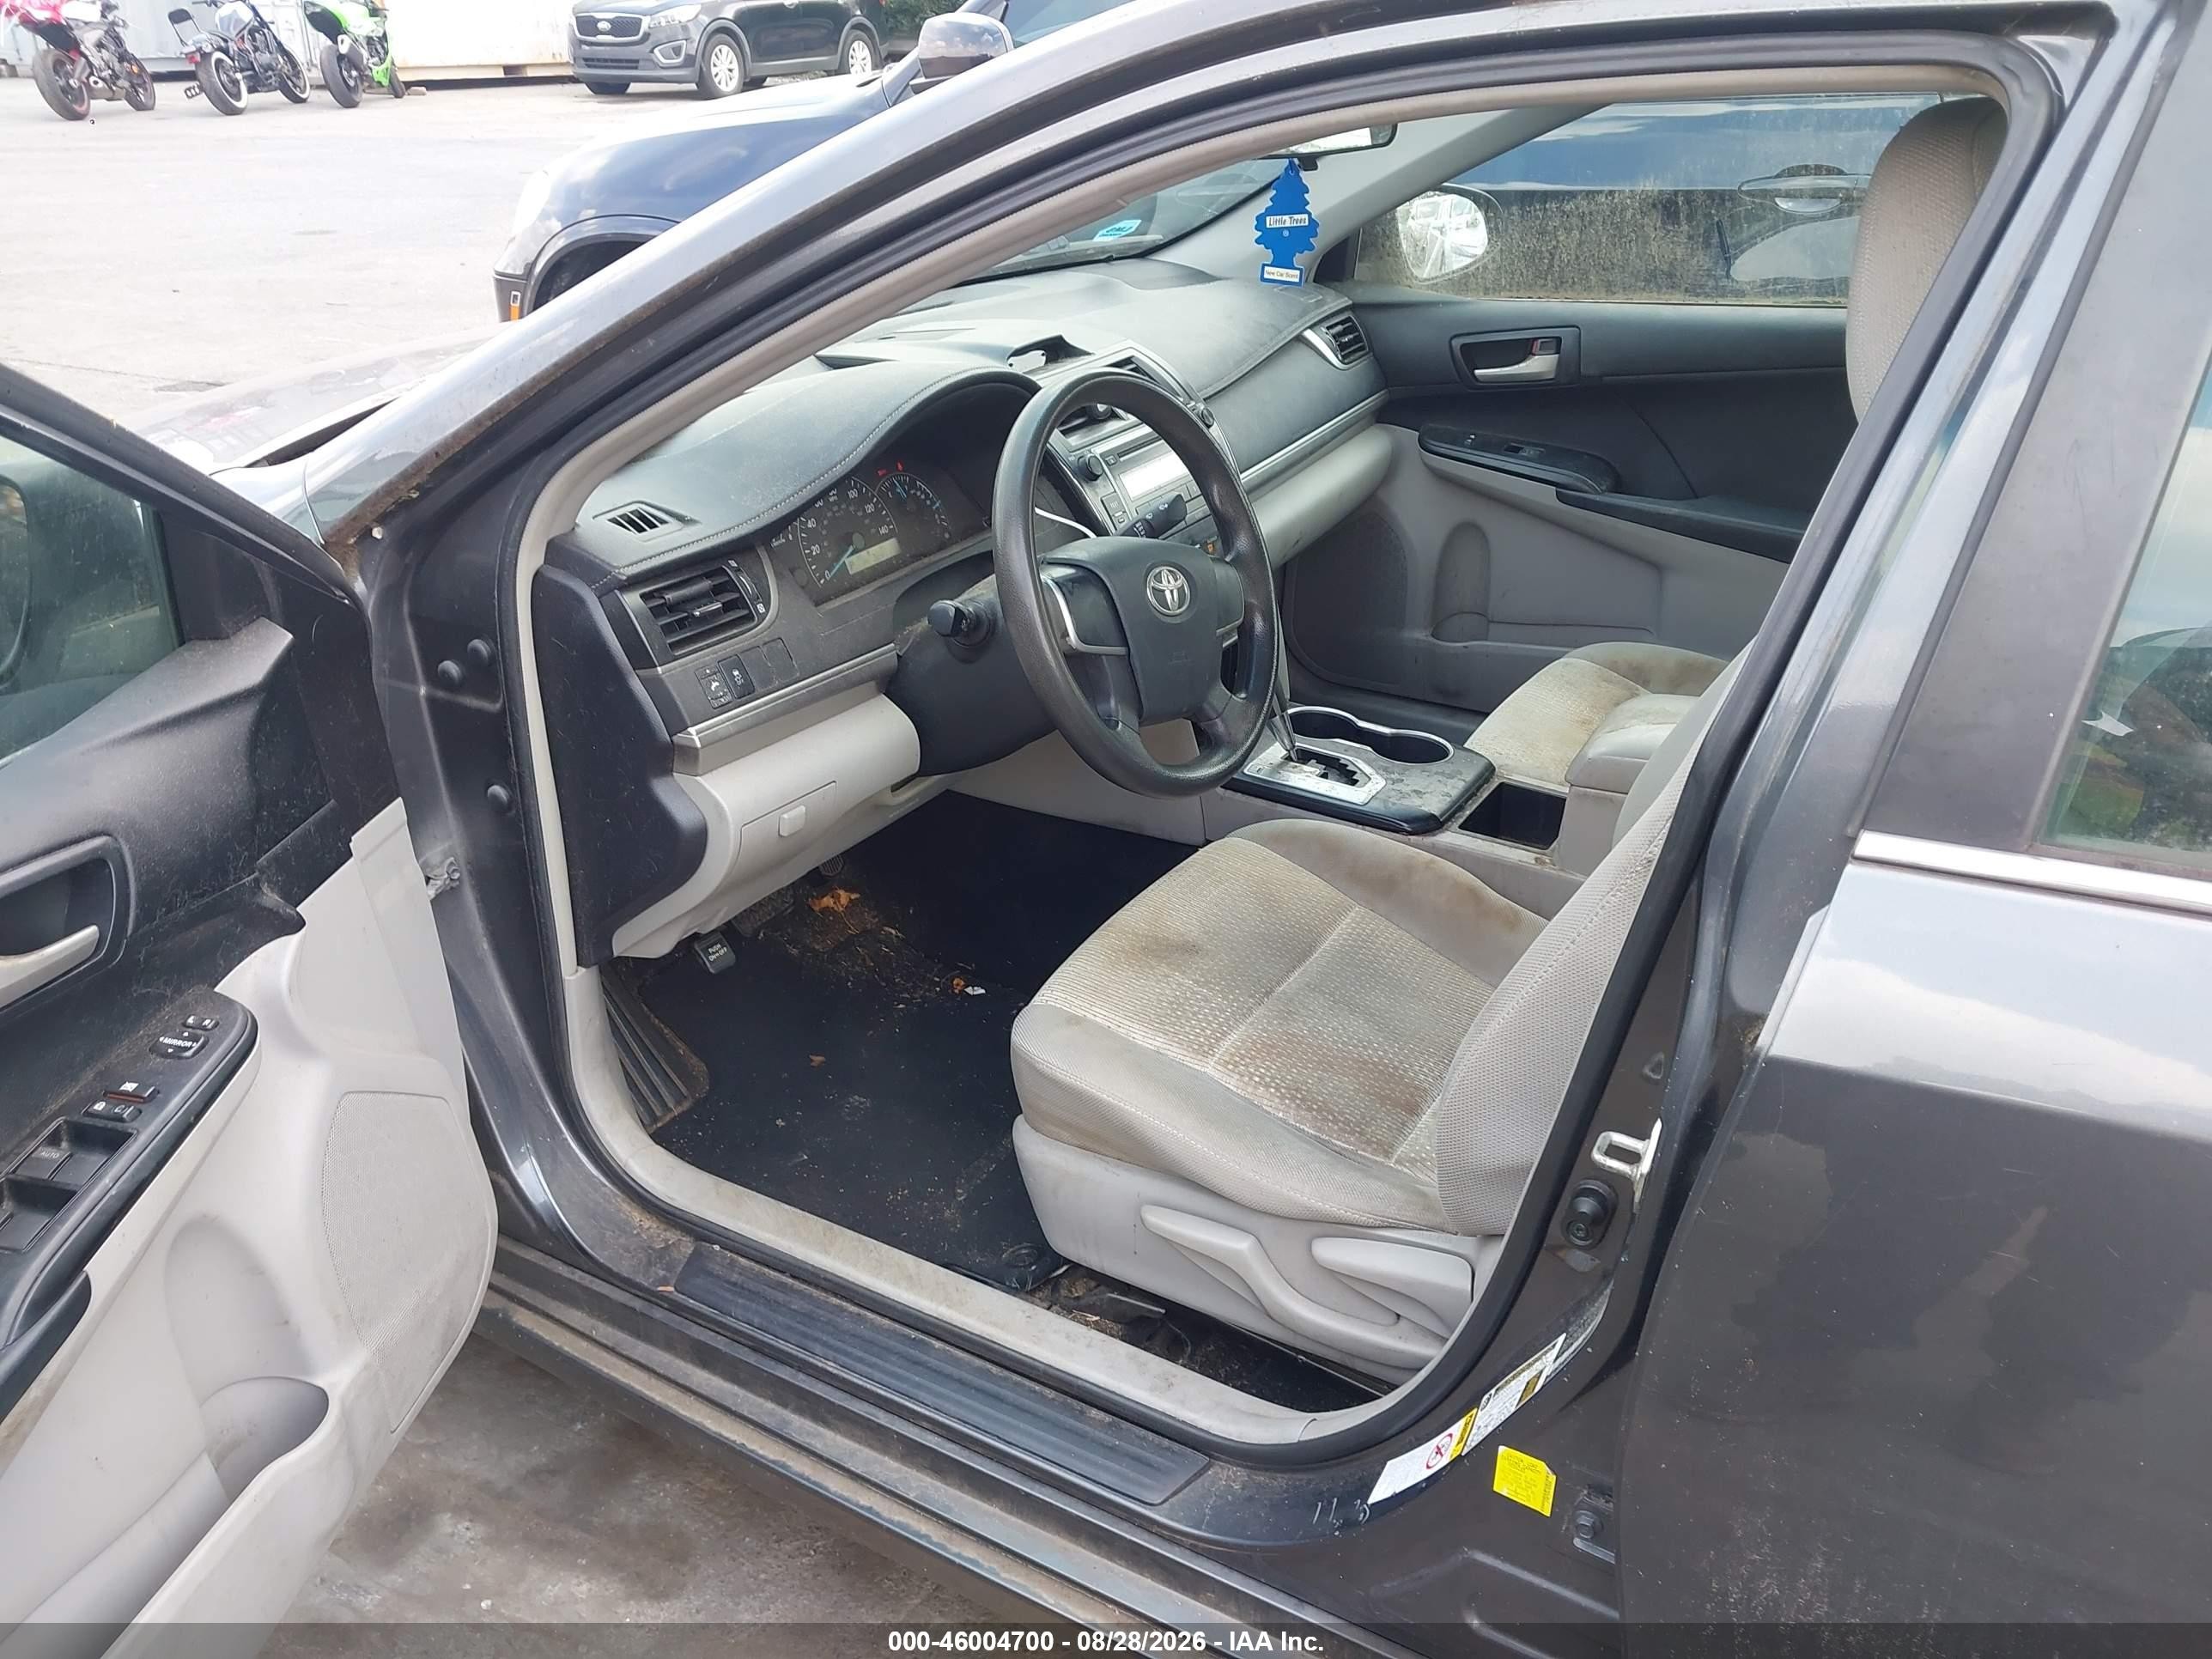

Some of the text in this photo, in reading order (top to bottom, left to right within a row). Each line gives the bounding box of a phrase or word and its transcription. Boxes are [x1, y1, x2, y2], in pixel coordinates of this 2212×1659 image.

[1268, 216, 1307, 227] Little Trees
[848, 488, 858, 500] 100
[864, 503, 874, 514] 120
[807, 518, 817, 528] 40
[878, 525, 889, 536] 140
[811, 544, 820, 556] 20
[162, 1036, 193, 1048] MIRROR
[40, 1150, 60, 1158] AUTO
